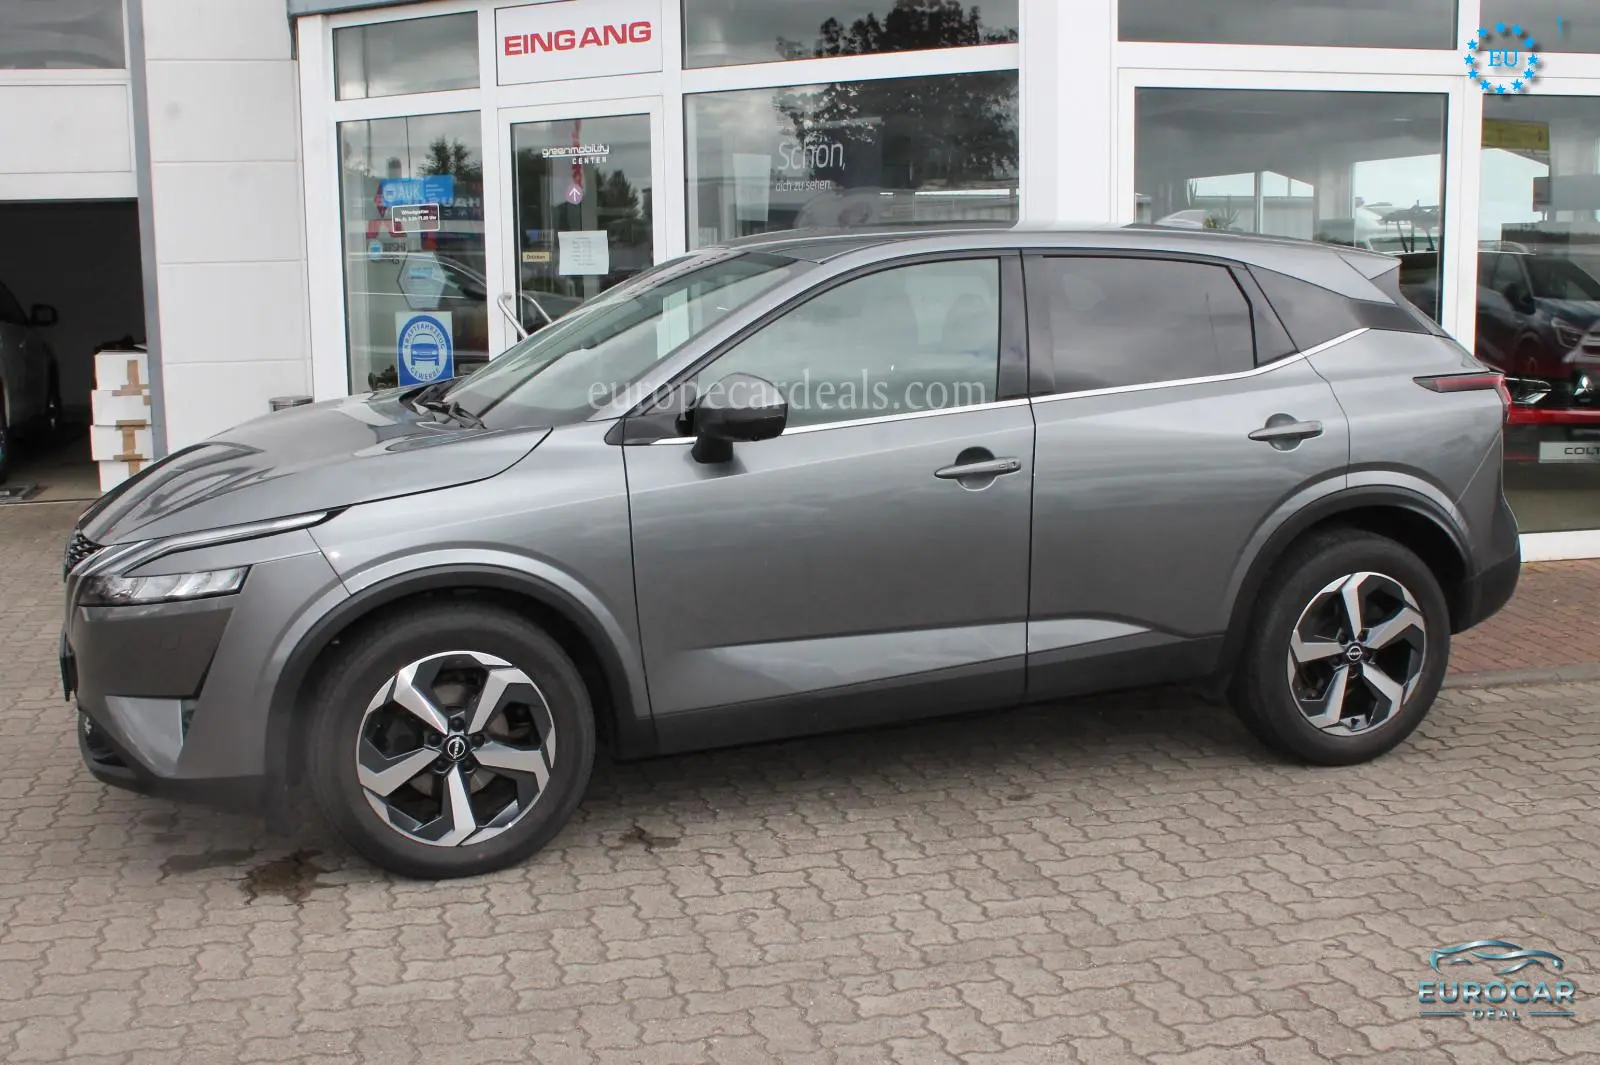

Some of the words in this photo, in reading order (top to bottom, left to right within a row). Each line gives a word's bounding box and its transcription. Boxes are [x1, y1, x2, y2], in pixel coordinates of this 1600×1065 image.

[504, 21, 651, 56] EINGANG
[541, 144, 610, 158] greenmobility
[572, 156, 607, 165] CENTER
[1564, 446, 1600, 455] COLT
